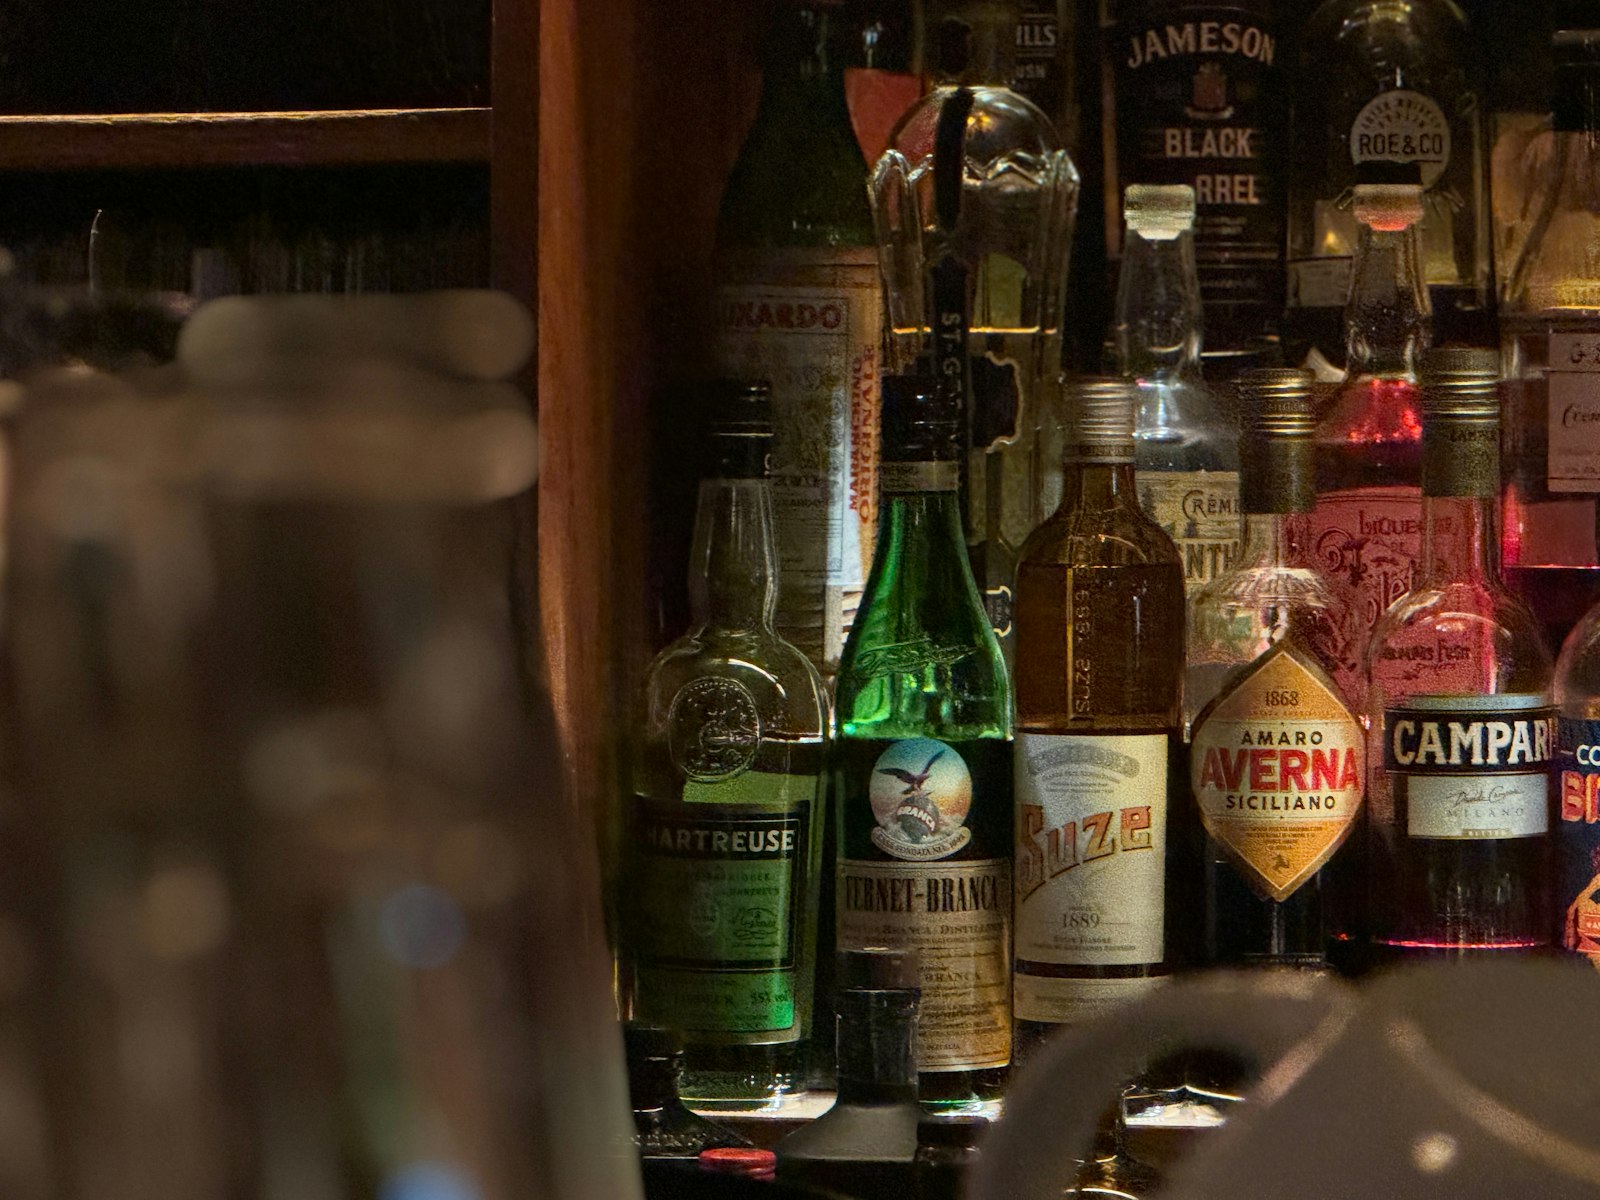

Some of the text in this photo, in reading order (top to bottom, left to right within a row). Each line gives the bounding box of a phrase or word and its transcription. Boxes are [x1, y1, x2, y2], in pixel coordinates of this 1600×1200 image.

[1015, 24, 1057, 46] ILLS
[1127, 22, 1276, 69] JAMESON
[1164, 127, 1253, 158] BLACK
[1359, 133, 1444, 156] ROE&CO
[1195, 174, 1260, 205] RREL
[728, 301, 843, 330] XARDO
[1178, 541, 1240, 580] NTH
[1265, 690, 1299, 707] 1868
[1241, 731, 1324, 745] AMARO
[1200, 746, 1361, 793] AVERNA
[1226, 795, 1336, 811] SICILIANO
[1561, 770, 1600, 824] BI
[896, 804, 937, 832] BRANCA
[648, 827, 796, 852] HARTREUSE
[1013, 803, 1153, 902] Suze
[1062, 913, 1100, 929] 1889
